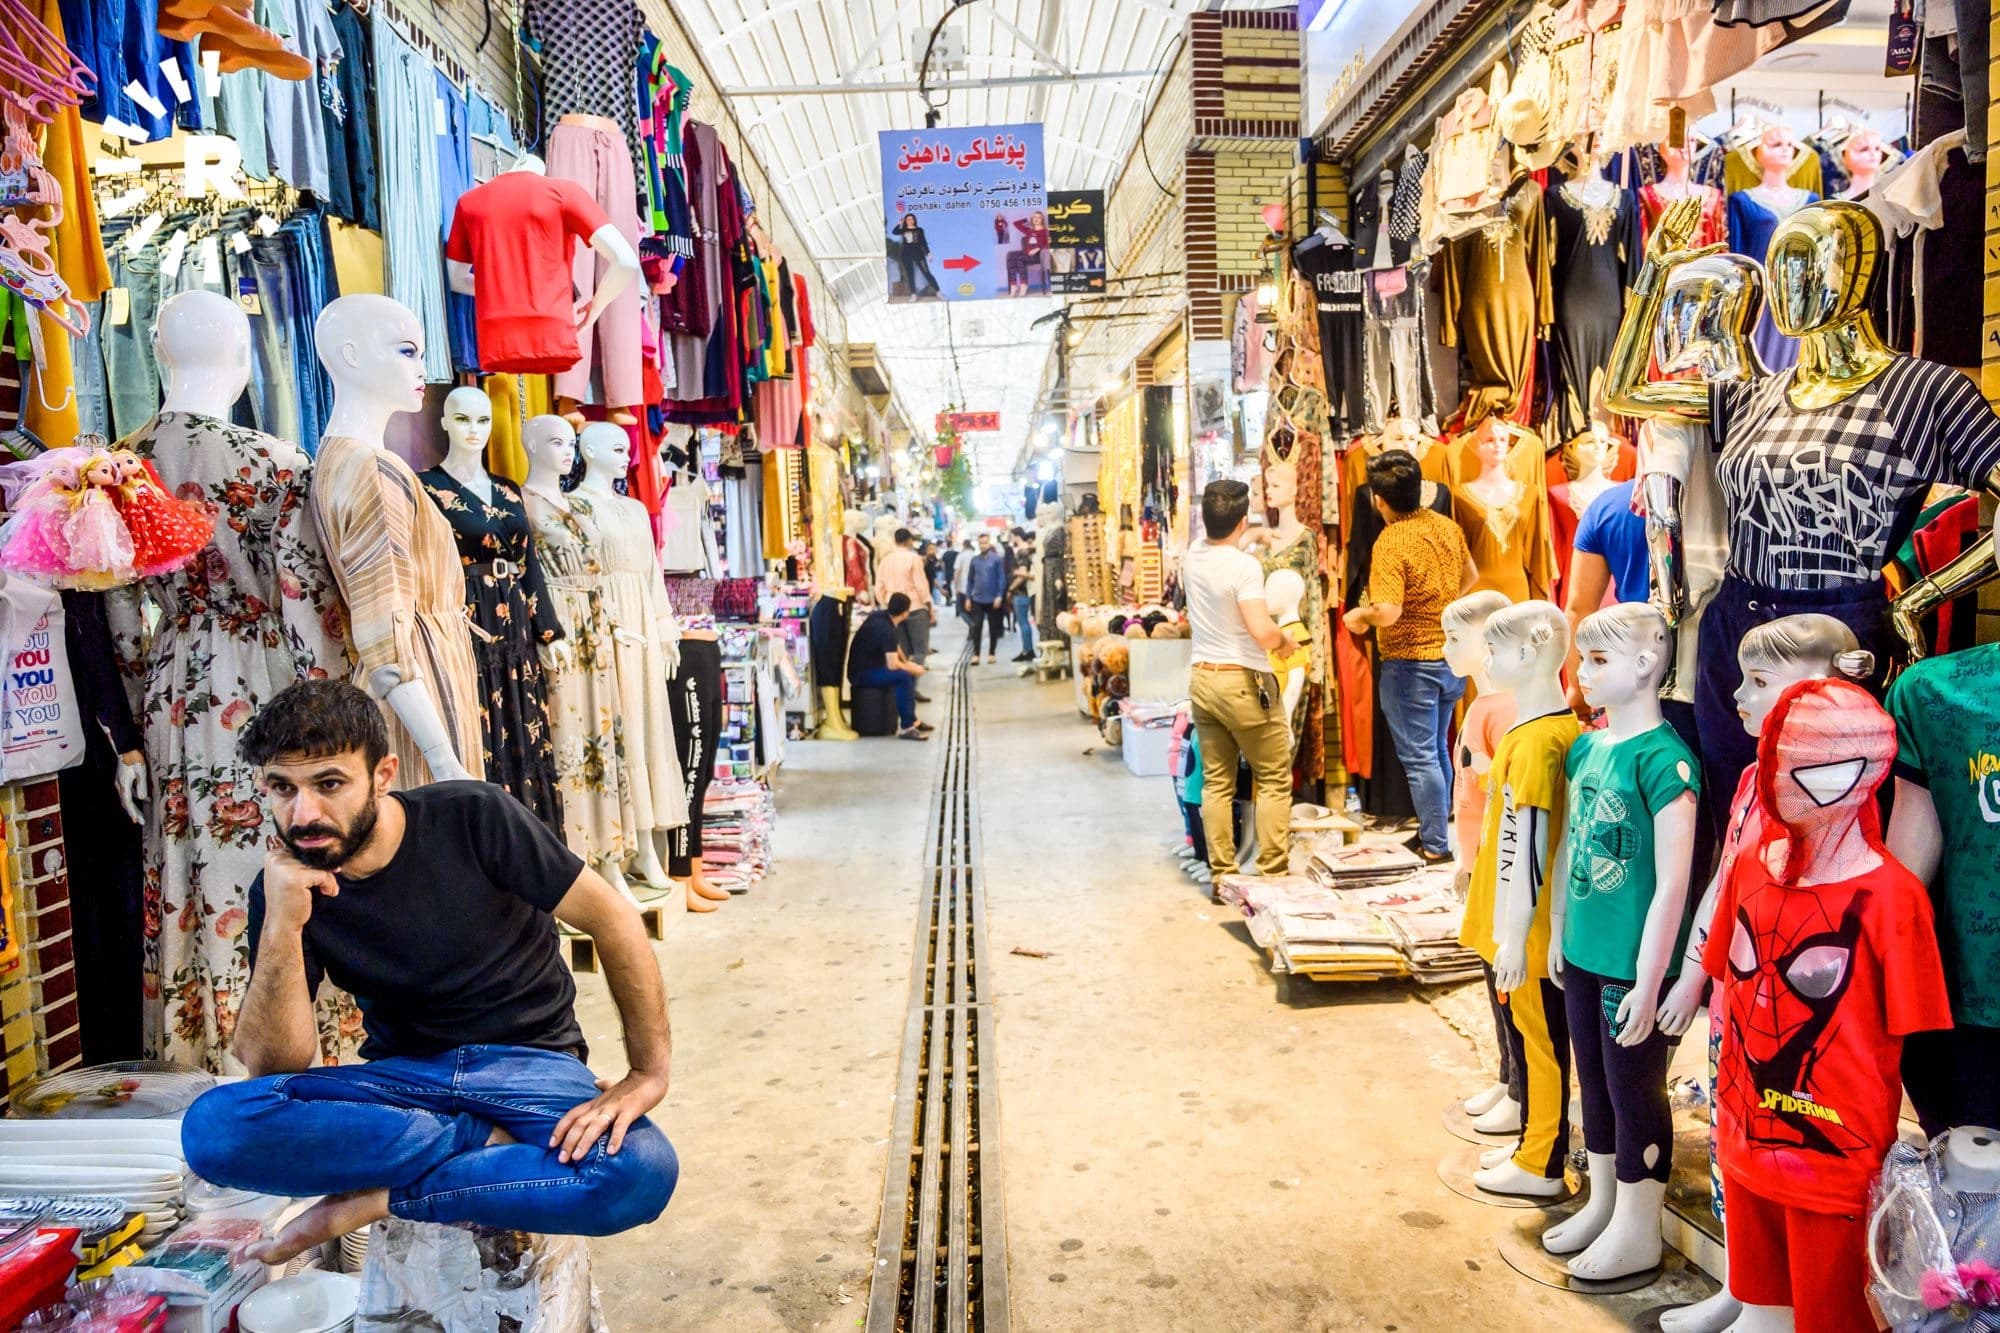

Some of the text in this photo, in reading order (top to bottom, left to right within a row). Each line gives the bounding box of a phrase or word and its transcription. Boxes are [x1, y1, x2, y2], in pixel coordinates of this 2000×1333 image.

[980, 199, 1001, 208] 0750
[1003, 198, 1019, 207] 456
[1022, 197, 1042, 206] 1859
[12, 668, 54, 689] YOU
[13, 684, 58, 706] YOU
[16, 703, 61, 726] YOU
[690, 691, 701, 724] adidas
[692, 738, 703, 769] adidas
[680, 827, 689, 858] adidas
